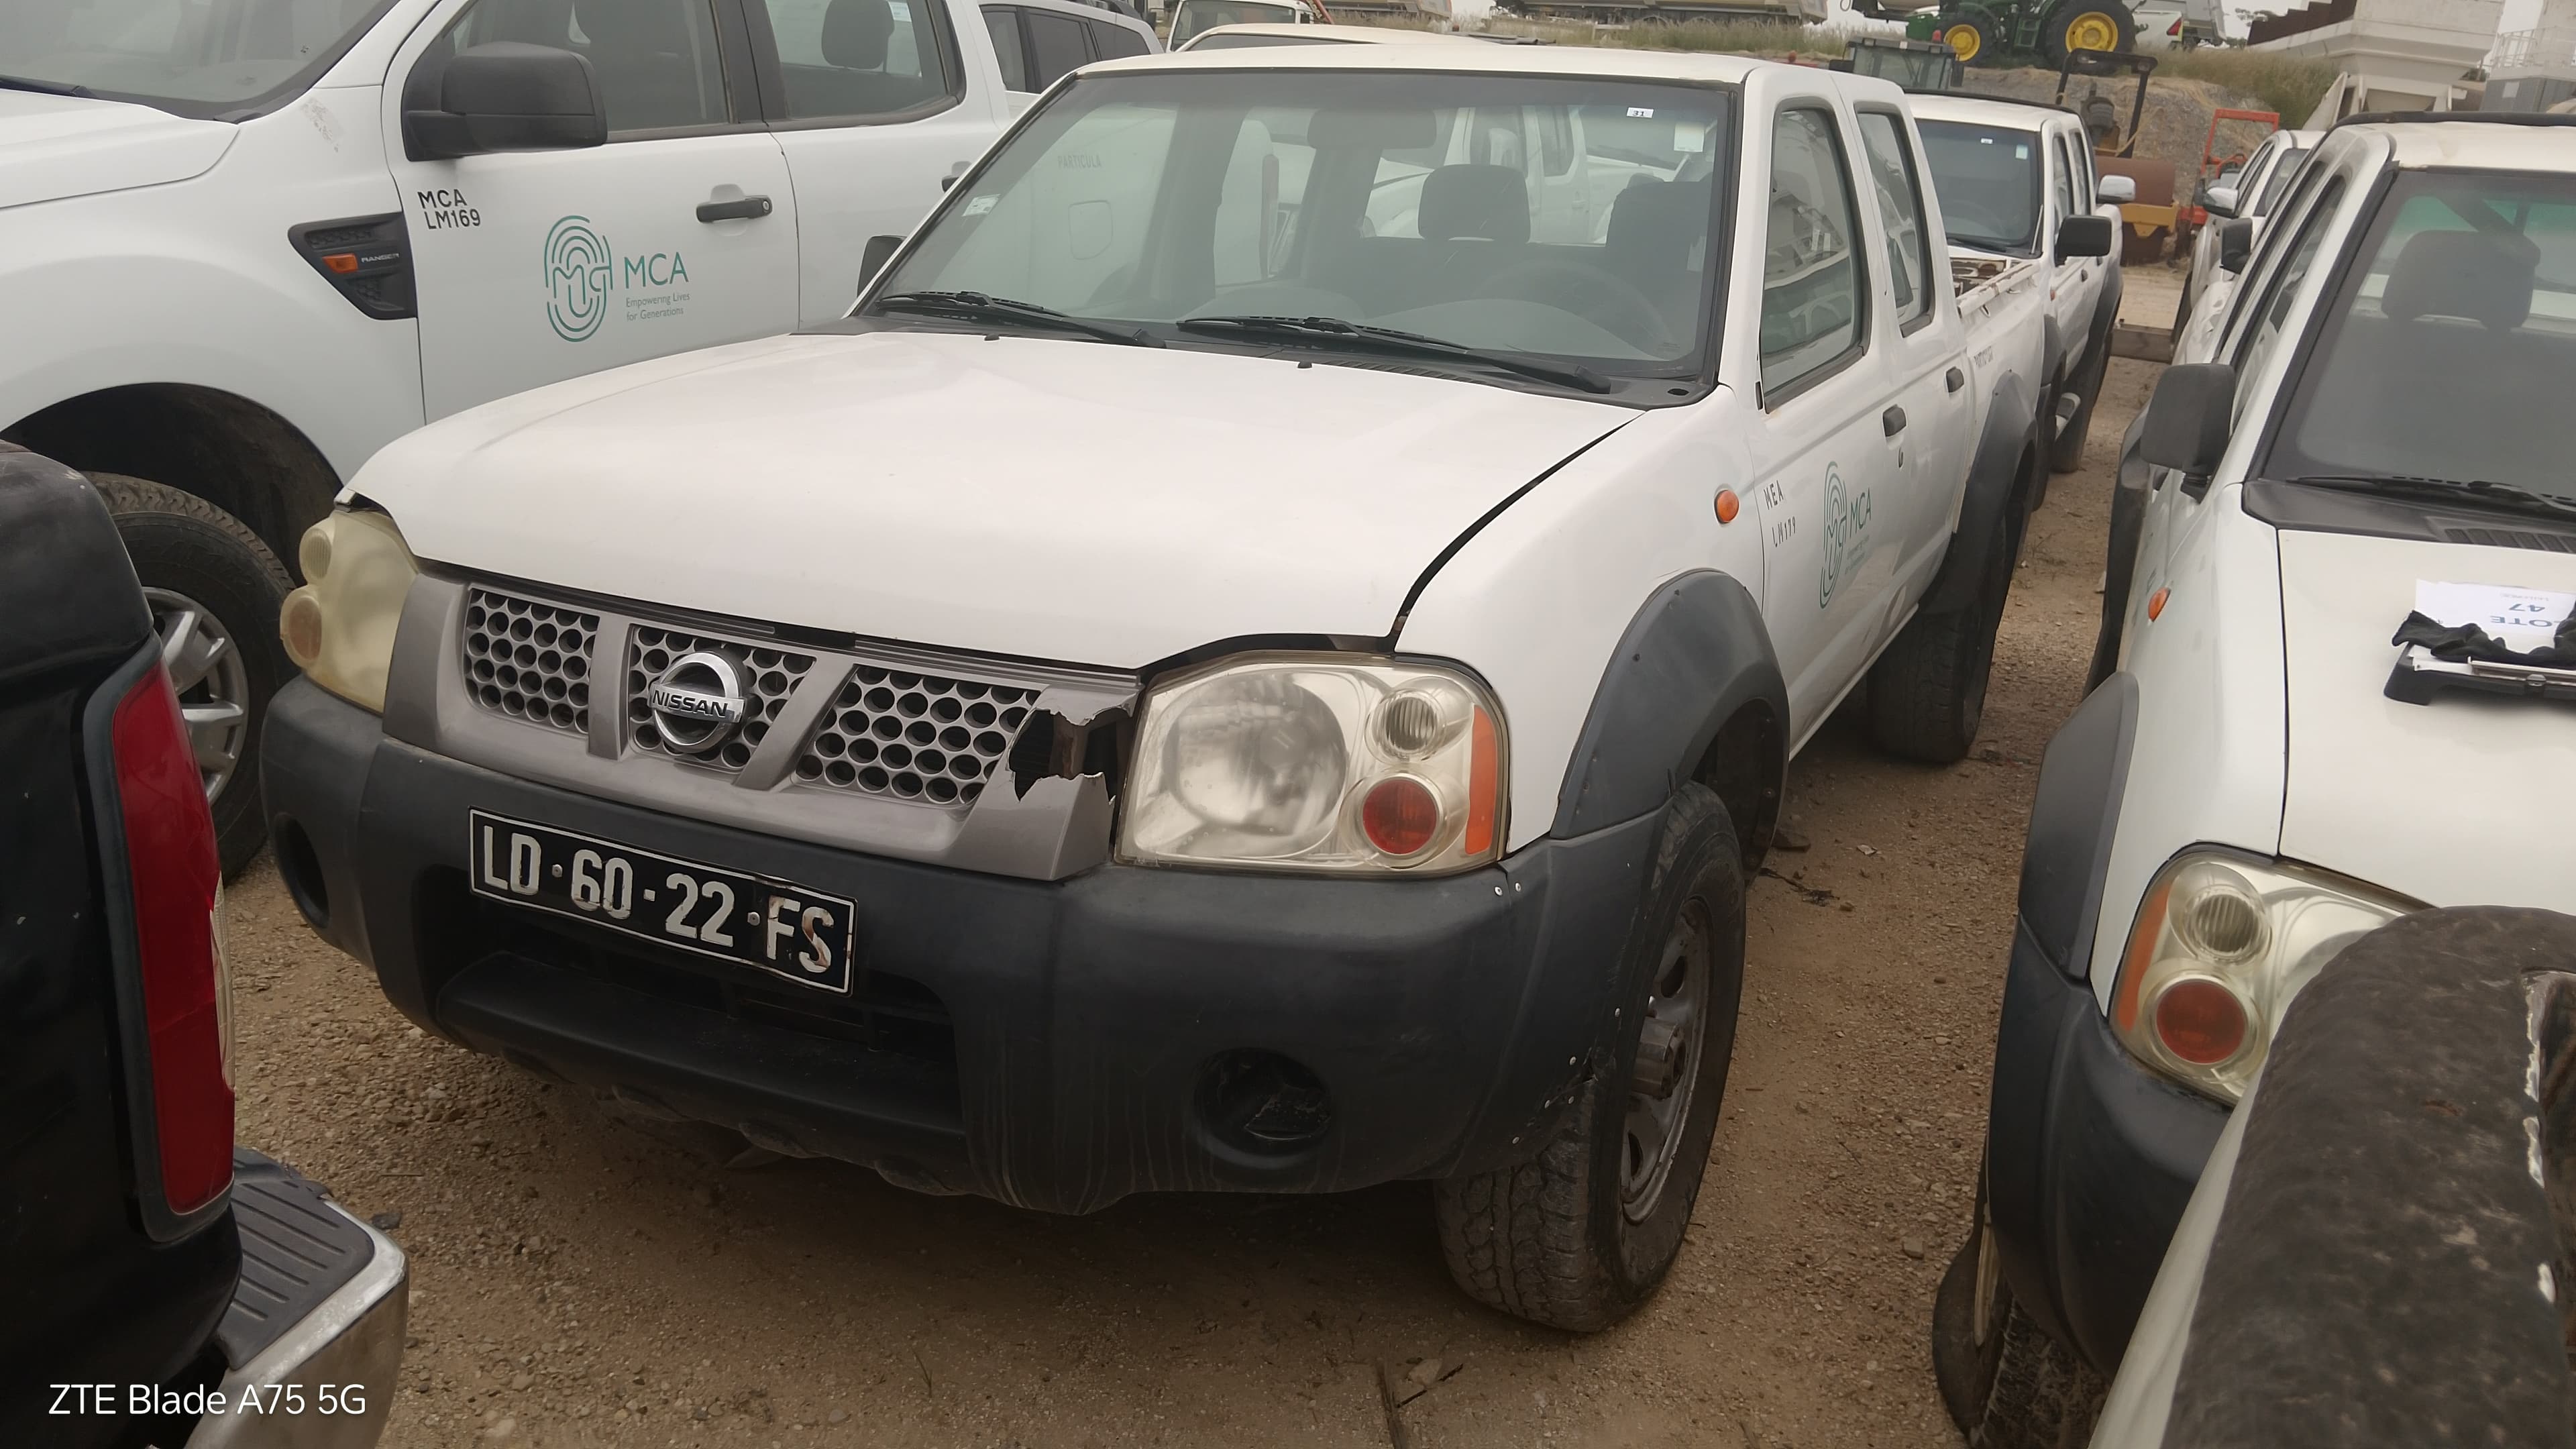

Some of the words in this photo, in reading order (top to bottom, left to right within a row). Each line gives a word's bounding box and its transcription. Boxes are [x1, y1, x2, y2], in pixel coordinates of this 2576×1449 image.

[417, 189, 468, 209] MCA
[424, 209, 480, 229] LM169
[624, 252, 689, 289] MCA
[626, 295, 671, 309] Empowering
[673, 292, 690, 302] Lives
[627, 311, 638, 321] for
[640, 307, 684, 320] Generations
[1849, 487, 1872, 539] MCA
[1772, 516, 1796, 547] LM179
[2509, 604, 2546, 612] 47
[653, 690, 729, 717] NISSAN
